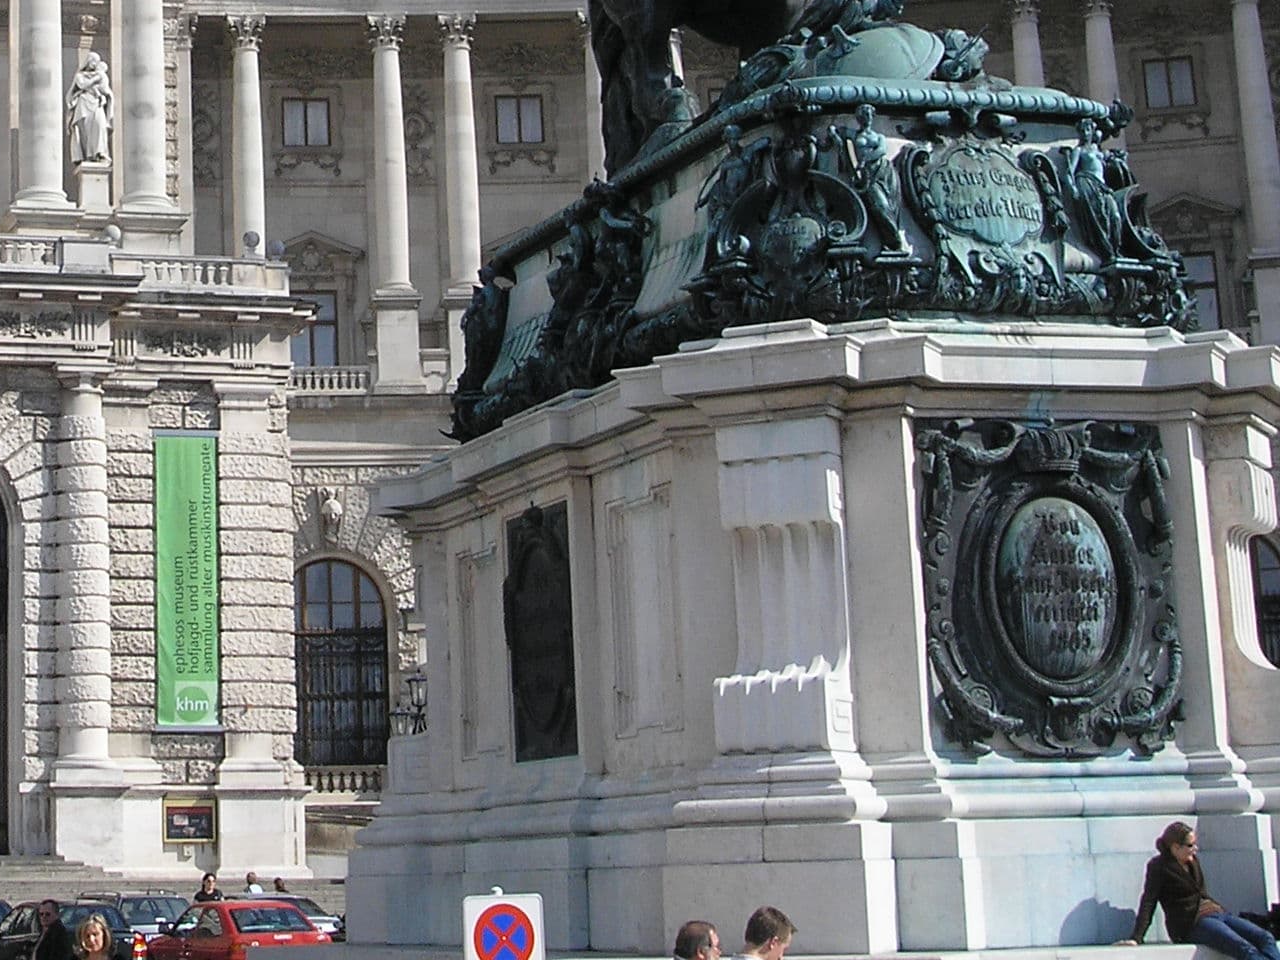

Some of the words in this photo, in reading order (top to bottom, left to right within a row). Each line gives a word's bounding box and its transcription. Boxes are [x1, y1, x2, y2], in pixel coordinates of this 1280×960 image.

[200, 442, 213, 563] musikinstrumente
[173, 555, 185, 614] museum
[187, 585, 199, 612] und
[201, 567, 213, 598] alter
[173, 618, 187, 674] ephesos
[187, 616, 200, 674] hofjagd-
[201, 603, 214, 674] sammlung
[176, 699, 209, 711] khm
